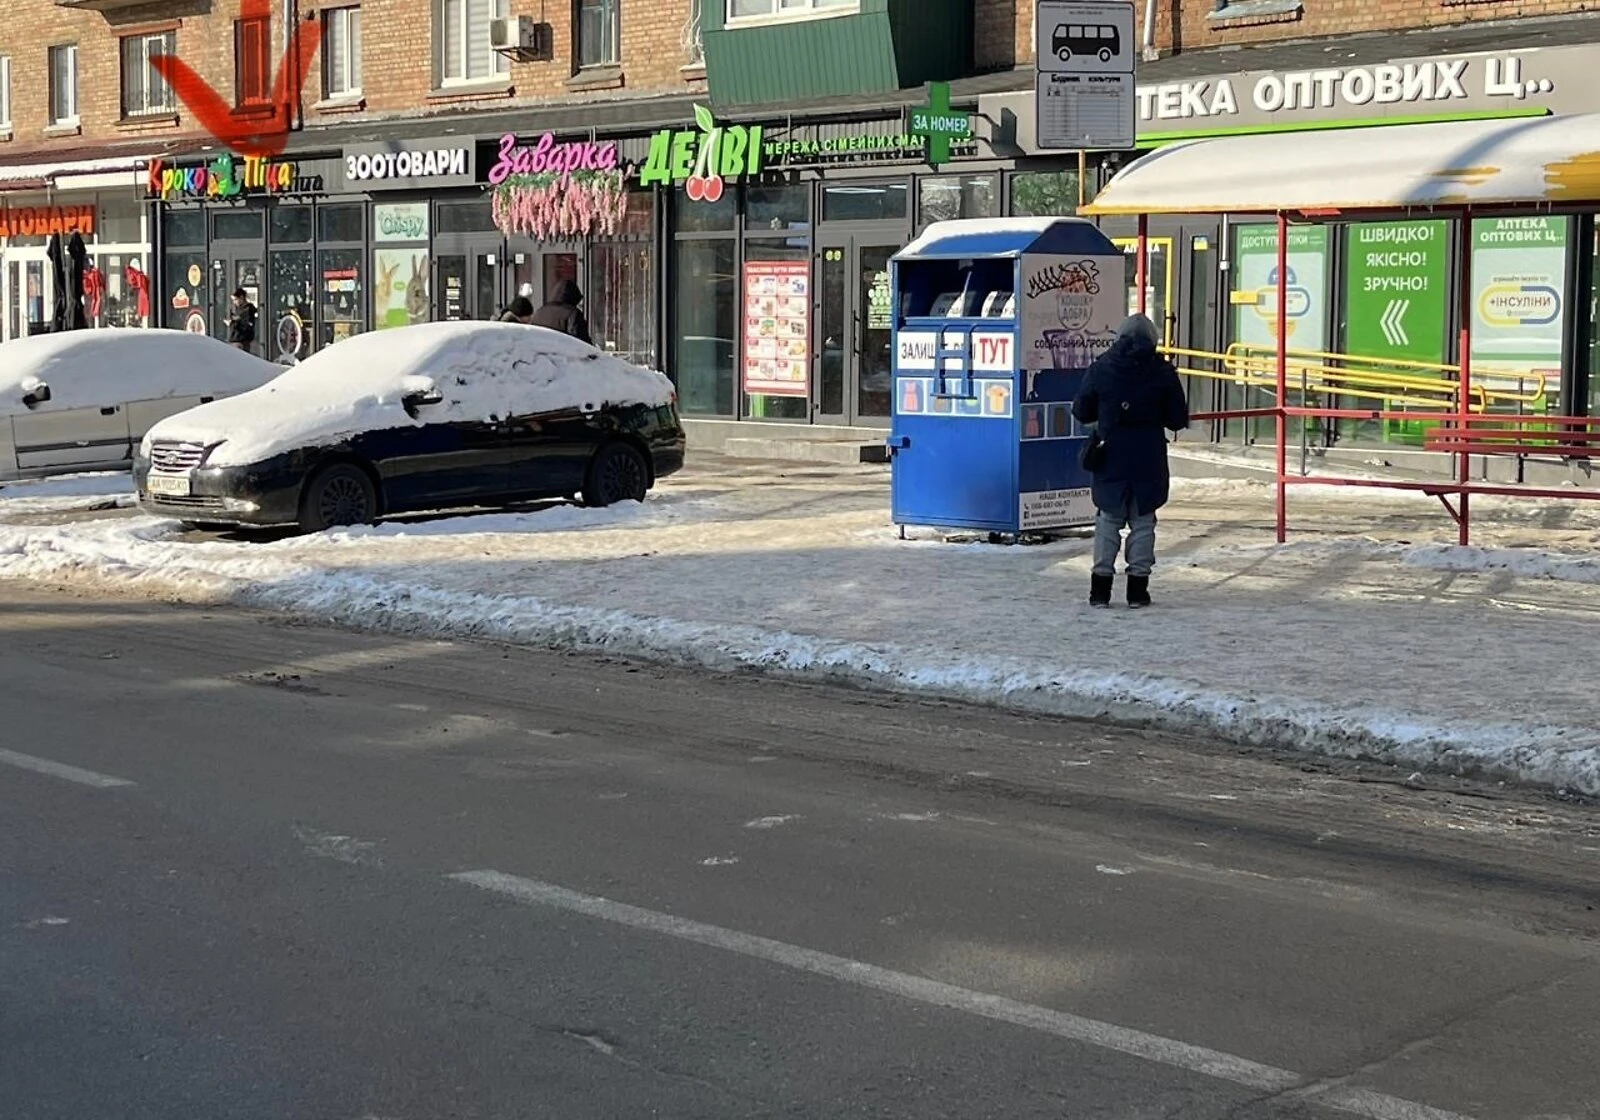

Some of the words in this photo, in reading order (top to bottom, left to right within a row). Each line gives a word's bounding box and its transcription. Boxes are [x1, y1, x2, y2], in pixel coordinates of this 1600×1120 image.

[1136, 80, 1238, 120] ТЕКА
[1253, 59, 1469, 111] ОПТОВИХ
[913, 114, 928, 131] ЗА
[930, 115, 968, 132] НОМЕР
[765, 140, 820, 155] МЕРЕЖА
[824, 134, 896, 151] СІМЕЙНИХ
[346, 149, 466, 180] ЗООТОВАРИ
[488, 131, 617, 189] Заварка
[148, 158, 208, 199] Кроко
[244, 155, 292, 192] Піца
[380, 214, 424, 238] Crispy
[1360, 226, 1434, 244] ШВИДКО!
[1496, 219, 1548, 230] АПТЕКА
[1480, 231, 1541, 242] ОПТОВИХ
[1365, 252, 1426, 267] ЯКІСНО!
[1364, 276, 1428, 291] ЗРУЧНО!
[979, 338, 1009, 364] ТУТ
